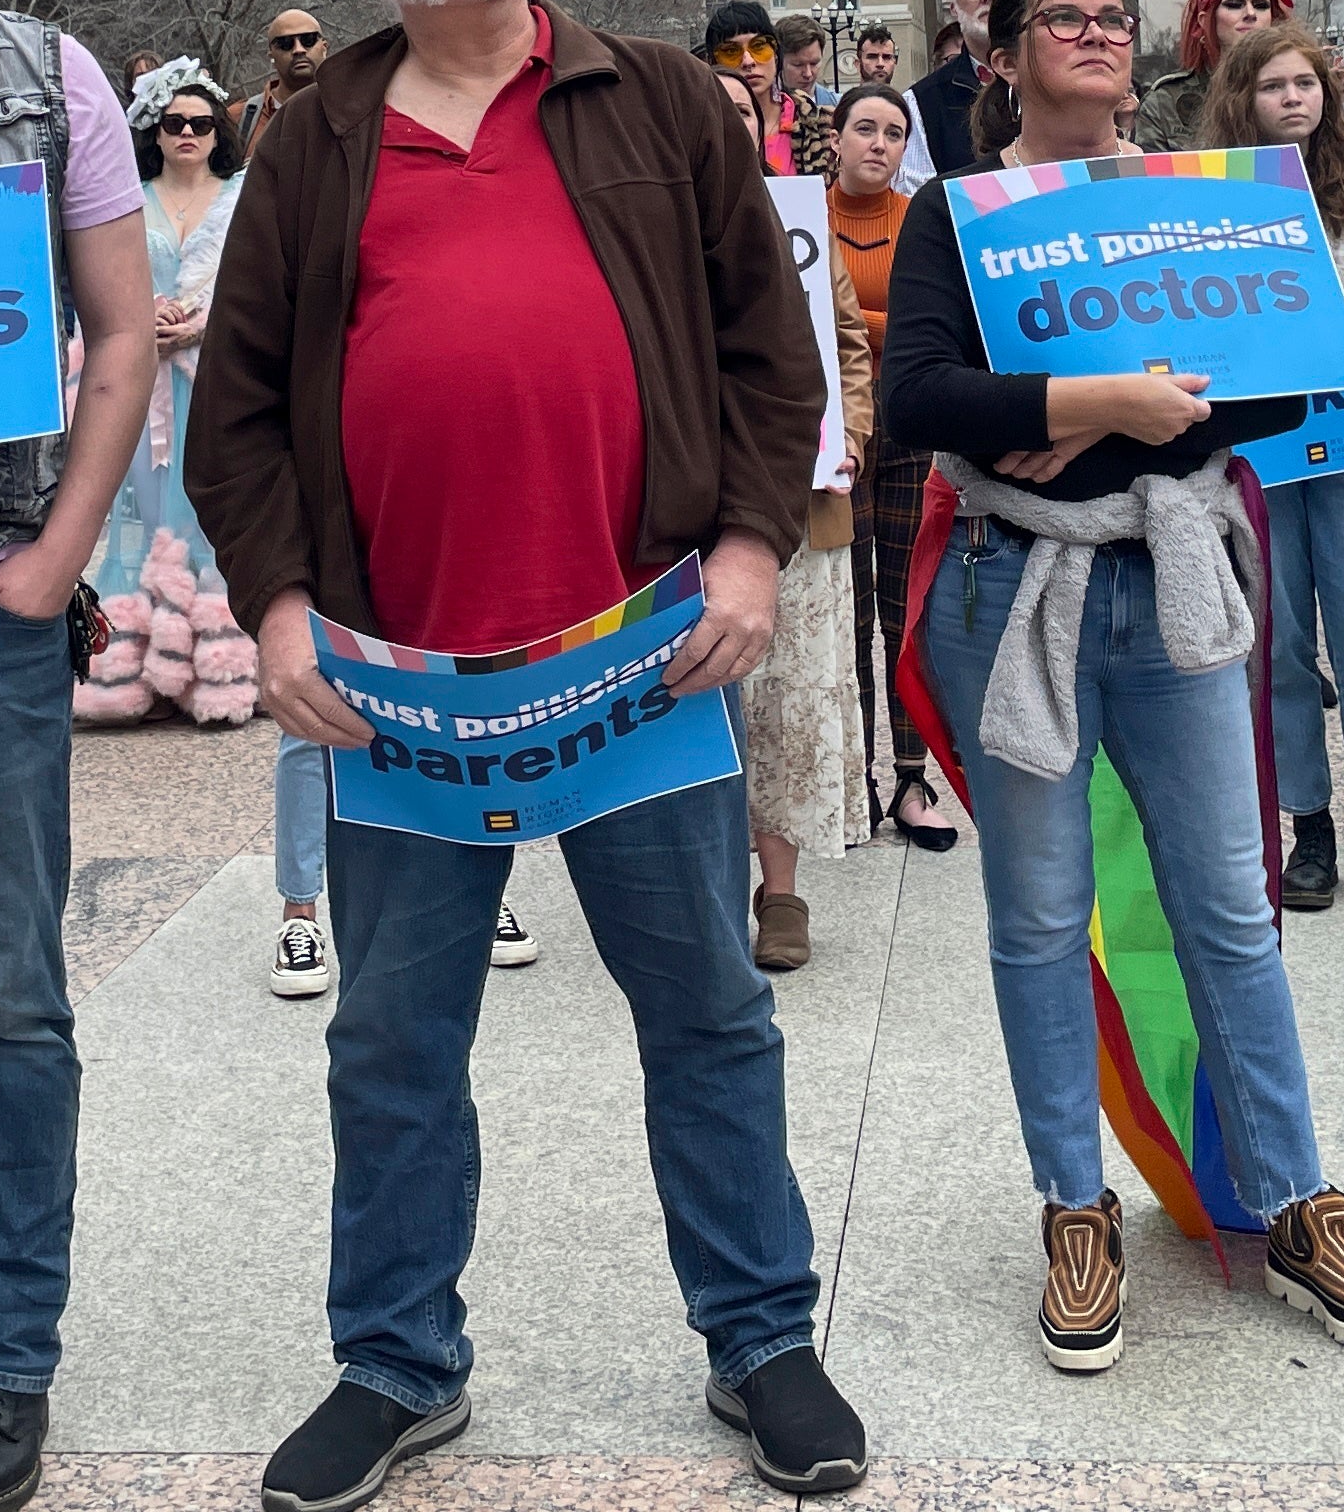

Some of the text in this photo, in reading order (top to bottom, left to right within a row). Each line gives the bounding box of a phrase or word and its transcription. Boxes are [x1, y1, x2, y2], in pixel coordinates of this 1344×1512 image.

[980, 218, 1309, 279] trust politicians
[1017, 268, 1311, 343] doctors
[333, 676, 441, 733] trust
[369, 682, 679, 787] parents
